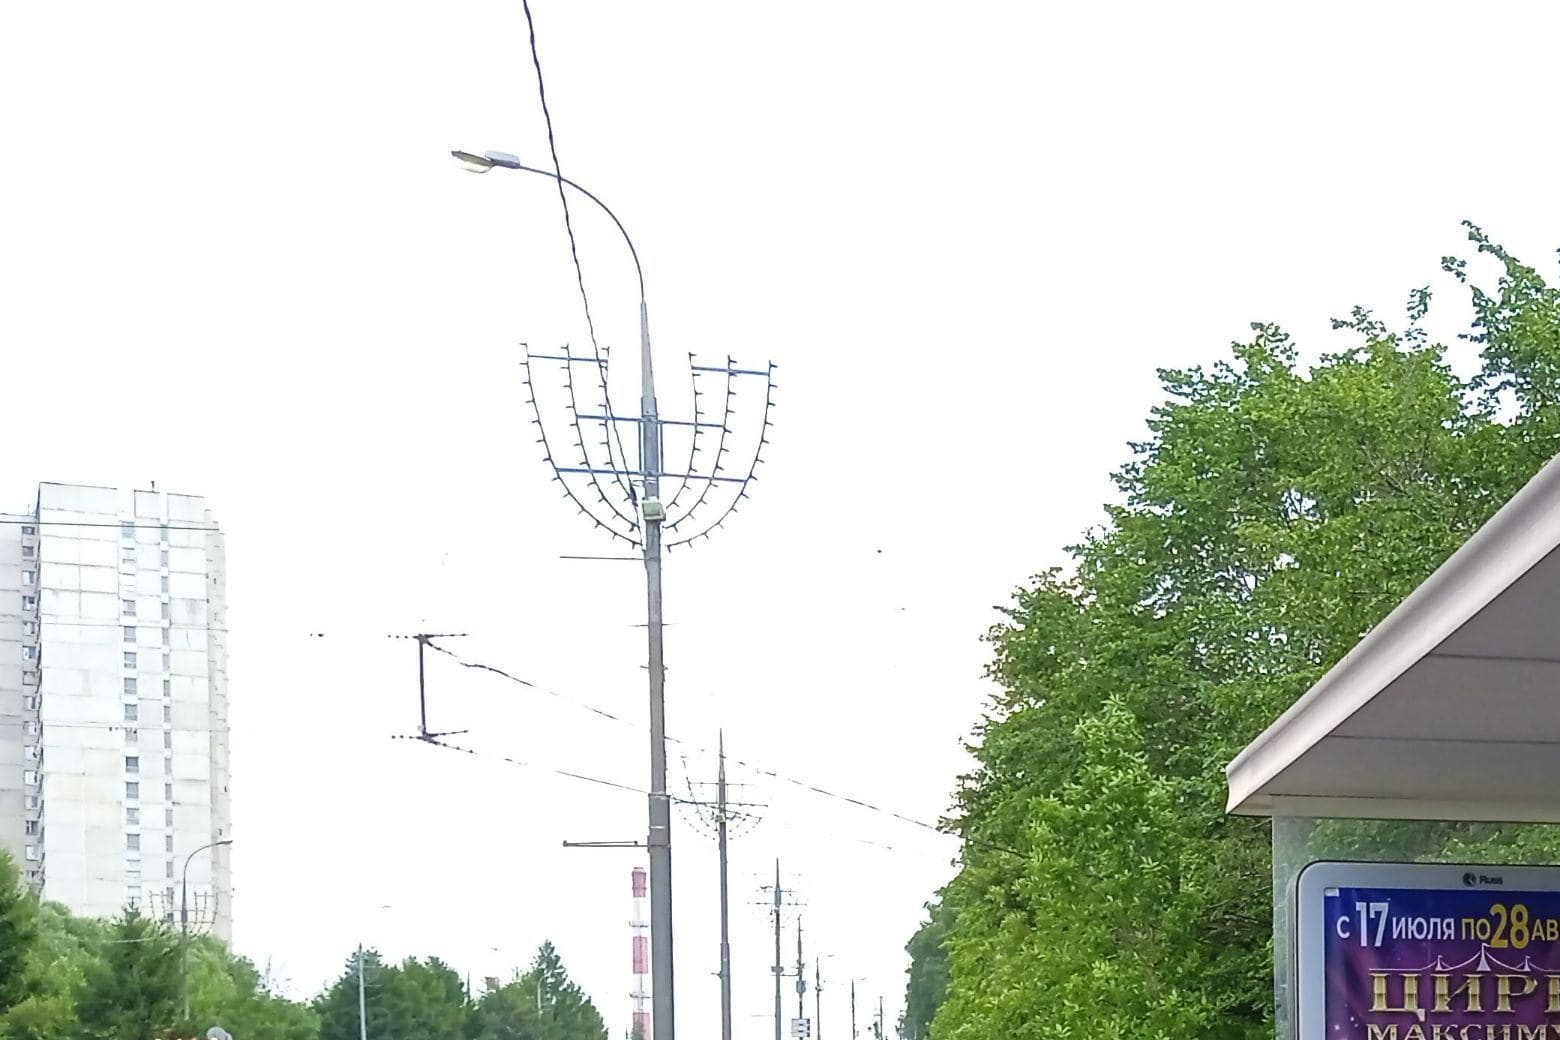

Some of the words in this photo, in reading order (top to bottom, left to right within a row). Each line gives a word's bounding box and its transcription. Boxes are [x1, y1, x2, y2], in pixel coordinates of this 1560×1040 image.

[1355, 902, 1389, 947] 17
[1392, 917, 1455, 940] ИЮЛЯ
[1461, 918, 1490, 940] ПО
[1489, 904, 1529, 949] 28
